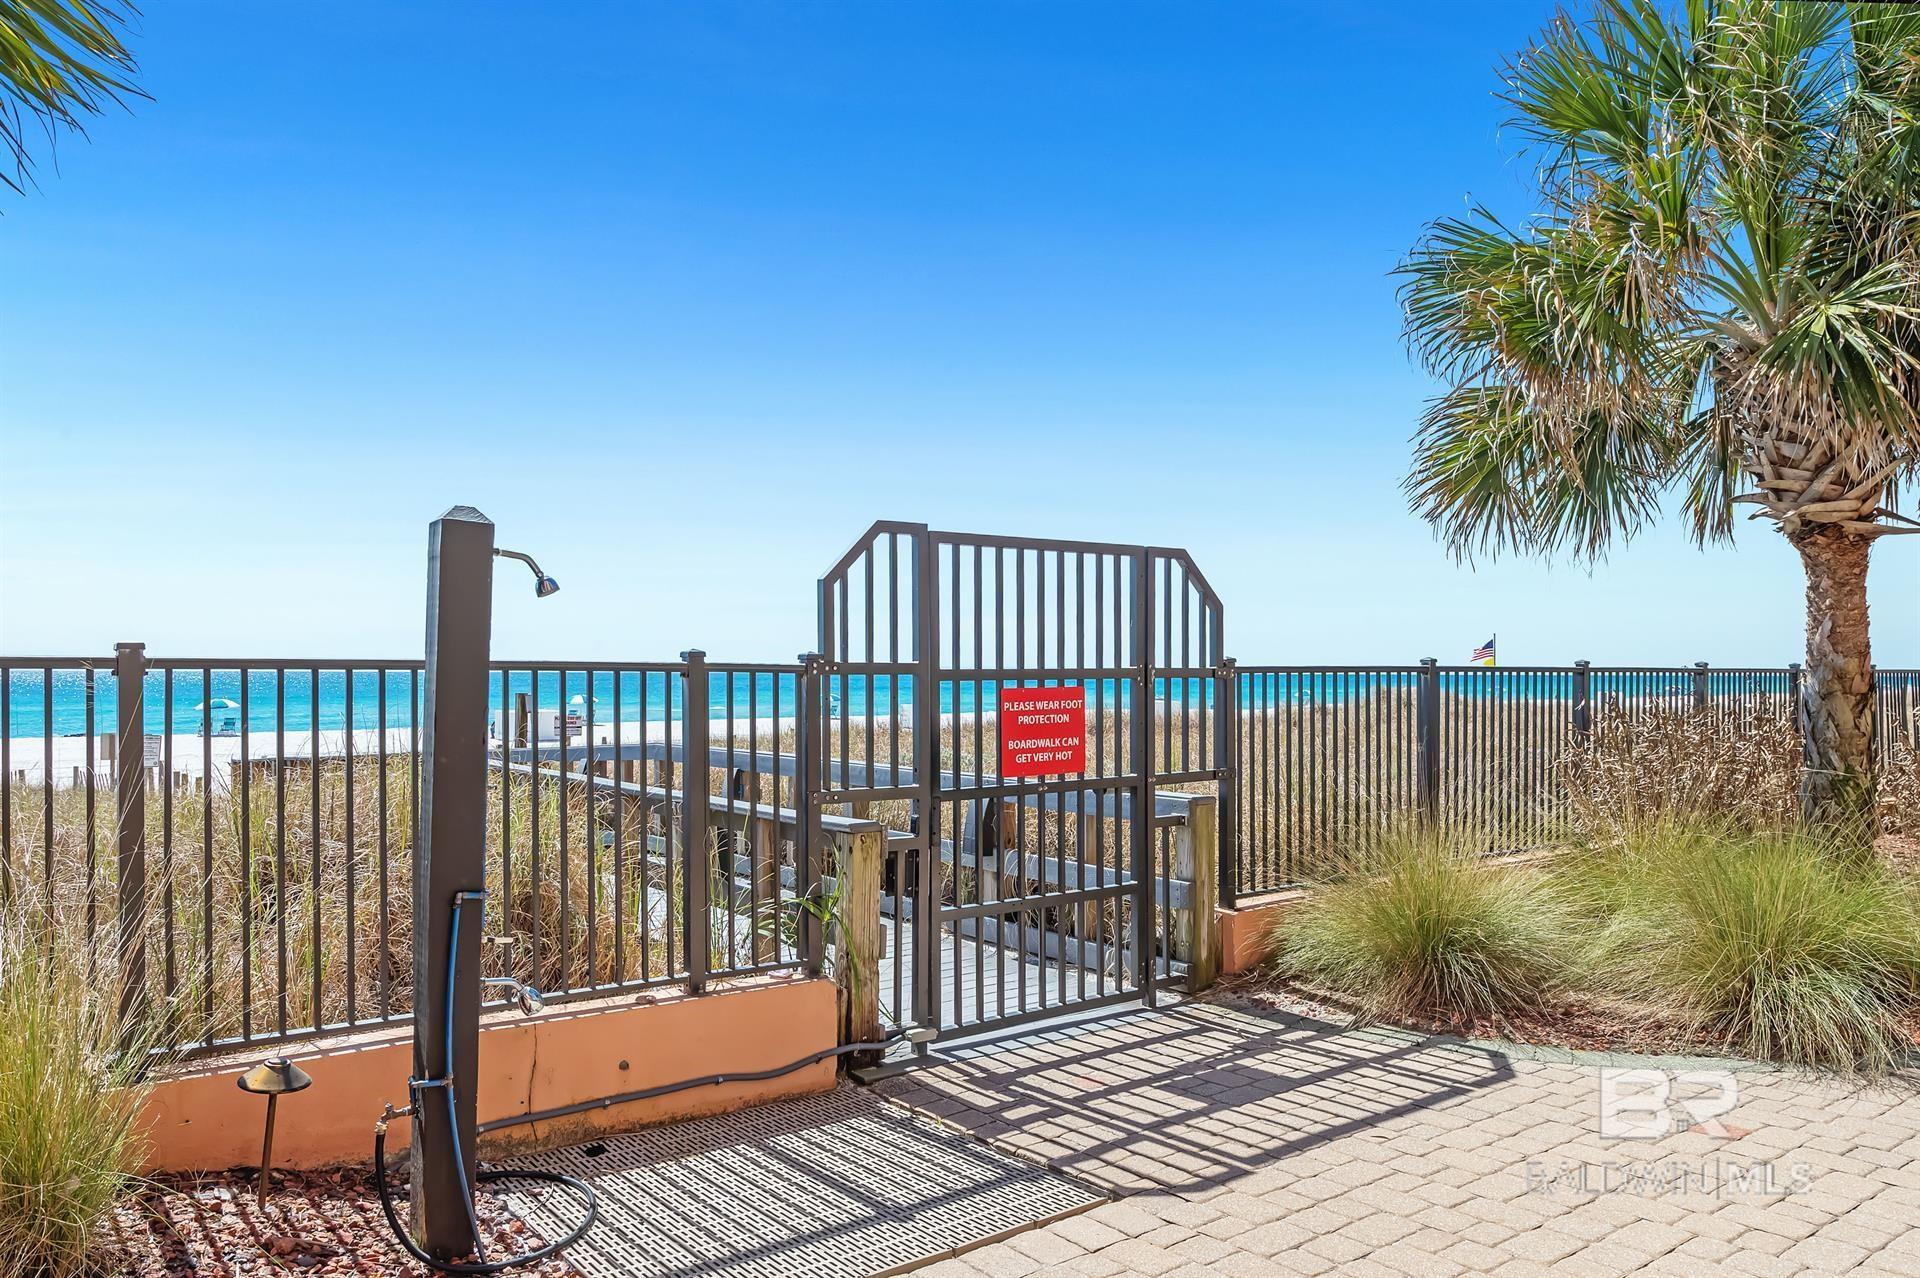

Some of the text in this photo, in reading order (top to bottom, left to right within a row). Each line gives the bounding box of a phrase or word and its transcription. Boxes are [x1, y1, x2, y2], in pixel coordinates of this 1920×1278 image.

[1004, 700, 1082, 711] PLEASE WEAR FOOT
[1018, 714, 1070, 725] PROTECTION
[1008, 737, 1079, 750] BOARDWALK CAN
[1015, 751, 1073, 763] GET VERY HOT
